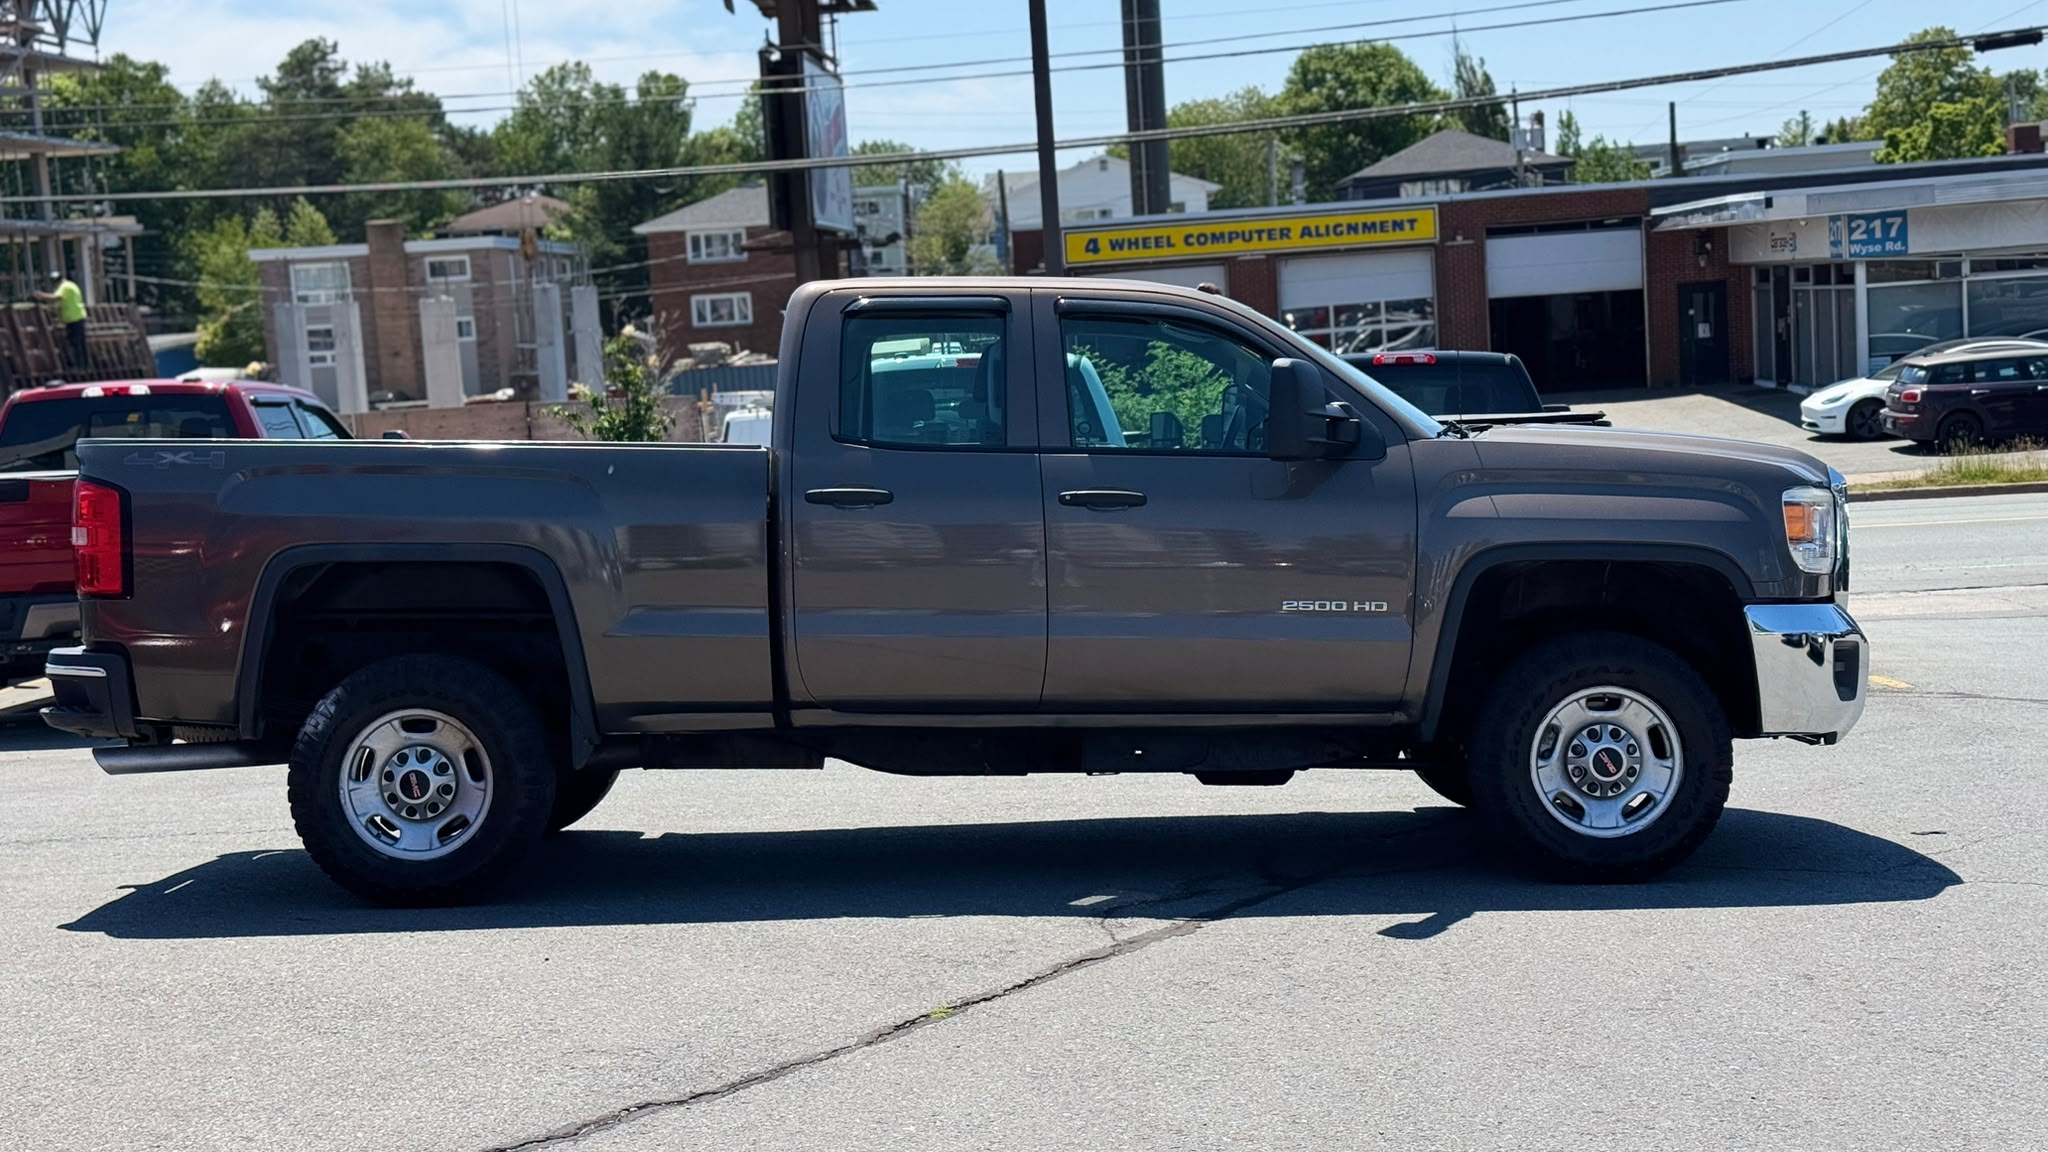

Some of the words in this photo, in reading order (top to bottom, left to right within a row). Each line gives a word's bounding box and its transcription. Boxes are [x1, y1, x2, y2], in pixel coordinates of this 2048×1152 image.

[1085, 238, 1101, 255] 4
[1108, 235, 1175, 252] WHEEL
[1183, 227, 1291, 247] COMPUTER
[1299, 218, 1418, 239] ALIGNMENT
[1850, 217, 1903, 240] 217
[1850, 243, 1882, 256] Wyse
[1885, 240, 1906, 252] Rd.
[1282, 600, 1347, 611] 2500
[1353, 601, 1388, 612] HD
[1598, 750, 1618, 774] GMC
